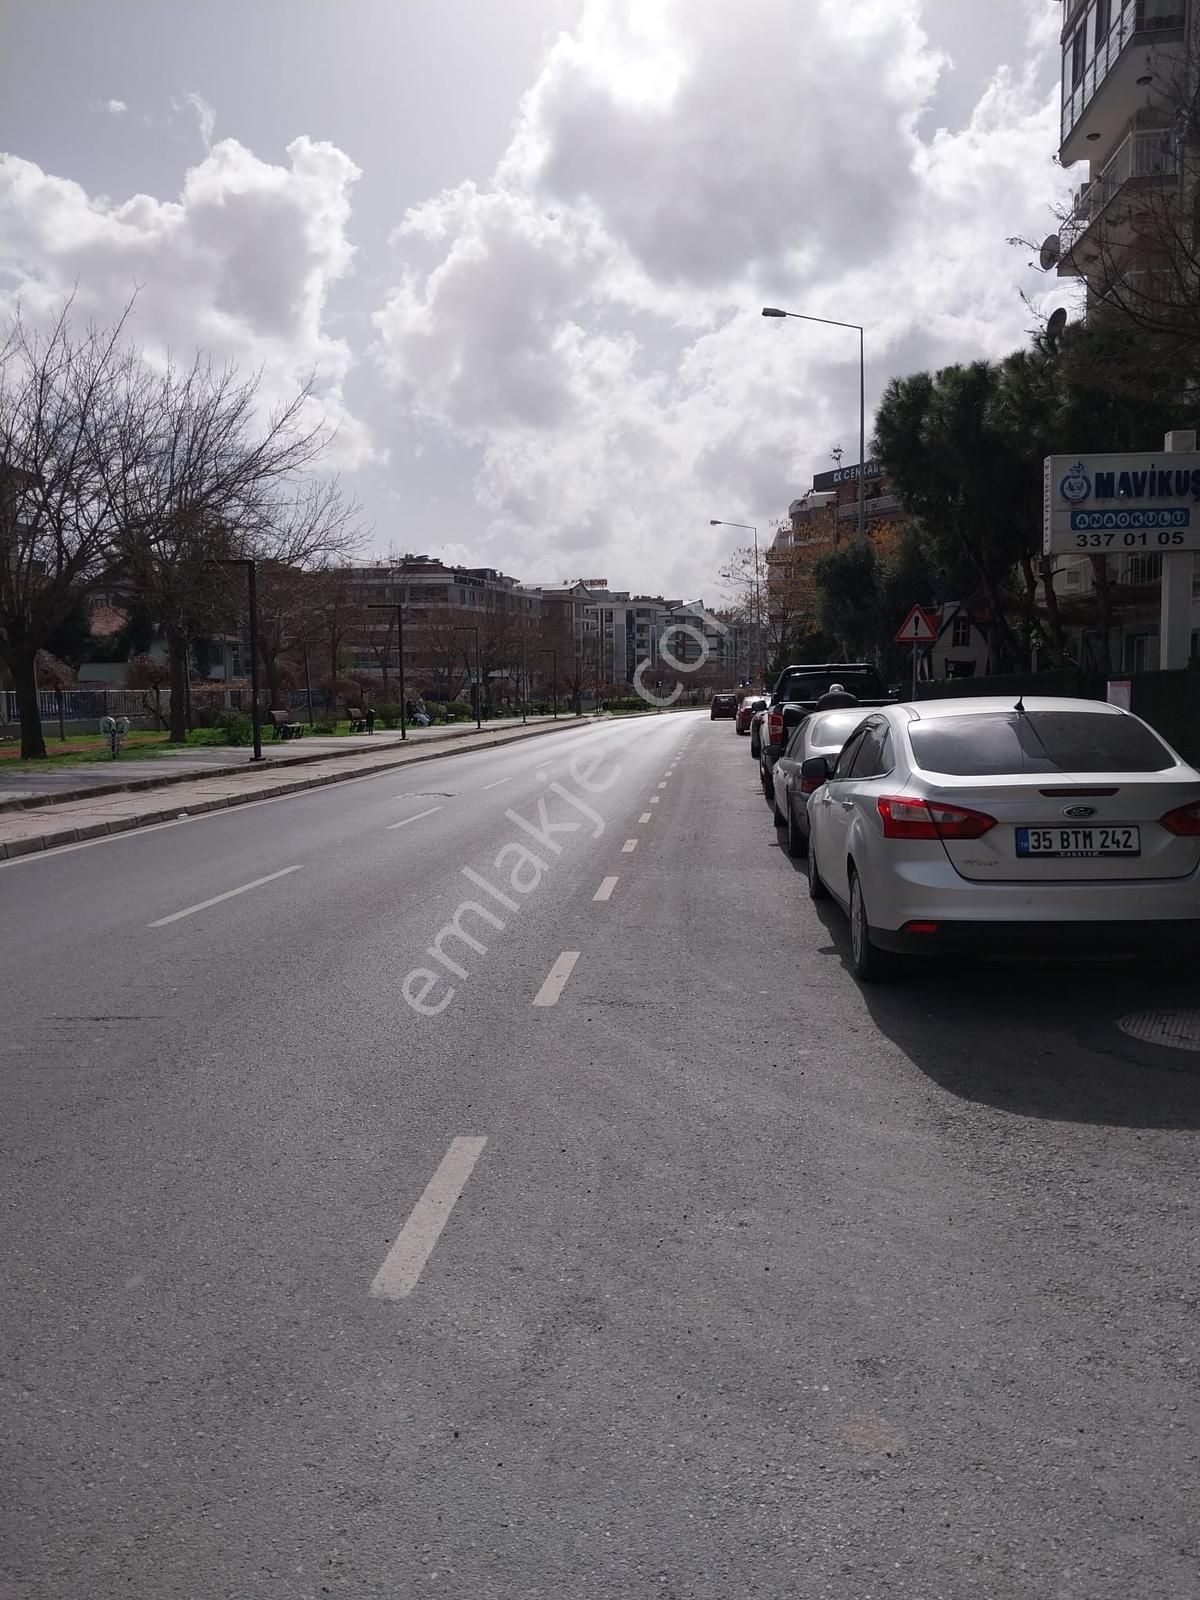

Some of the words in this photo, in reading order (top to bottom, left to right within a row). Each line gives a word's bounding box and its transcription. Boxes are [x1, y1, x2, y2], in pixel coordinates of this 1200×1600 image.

[1076, 510, 1185, 529] ANAOKULU
[1076, 533, 1115, 547] 337
[1123, 532, 1147, 546] 01
[1157, 531, 1184, 545] 05
[1031, 831, 1053, 850] 35
[1060, 830, 1093, 849] BTM
[1099, 830, 1133, 849] 242
